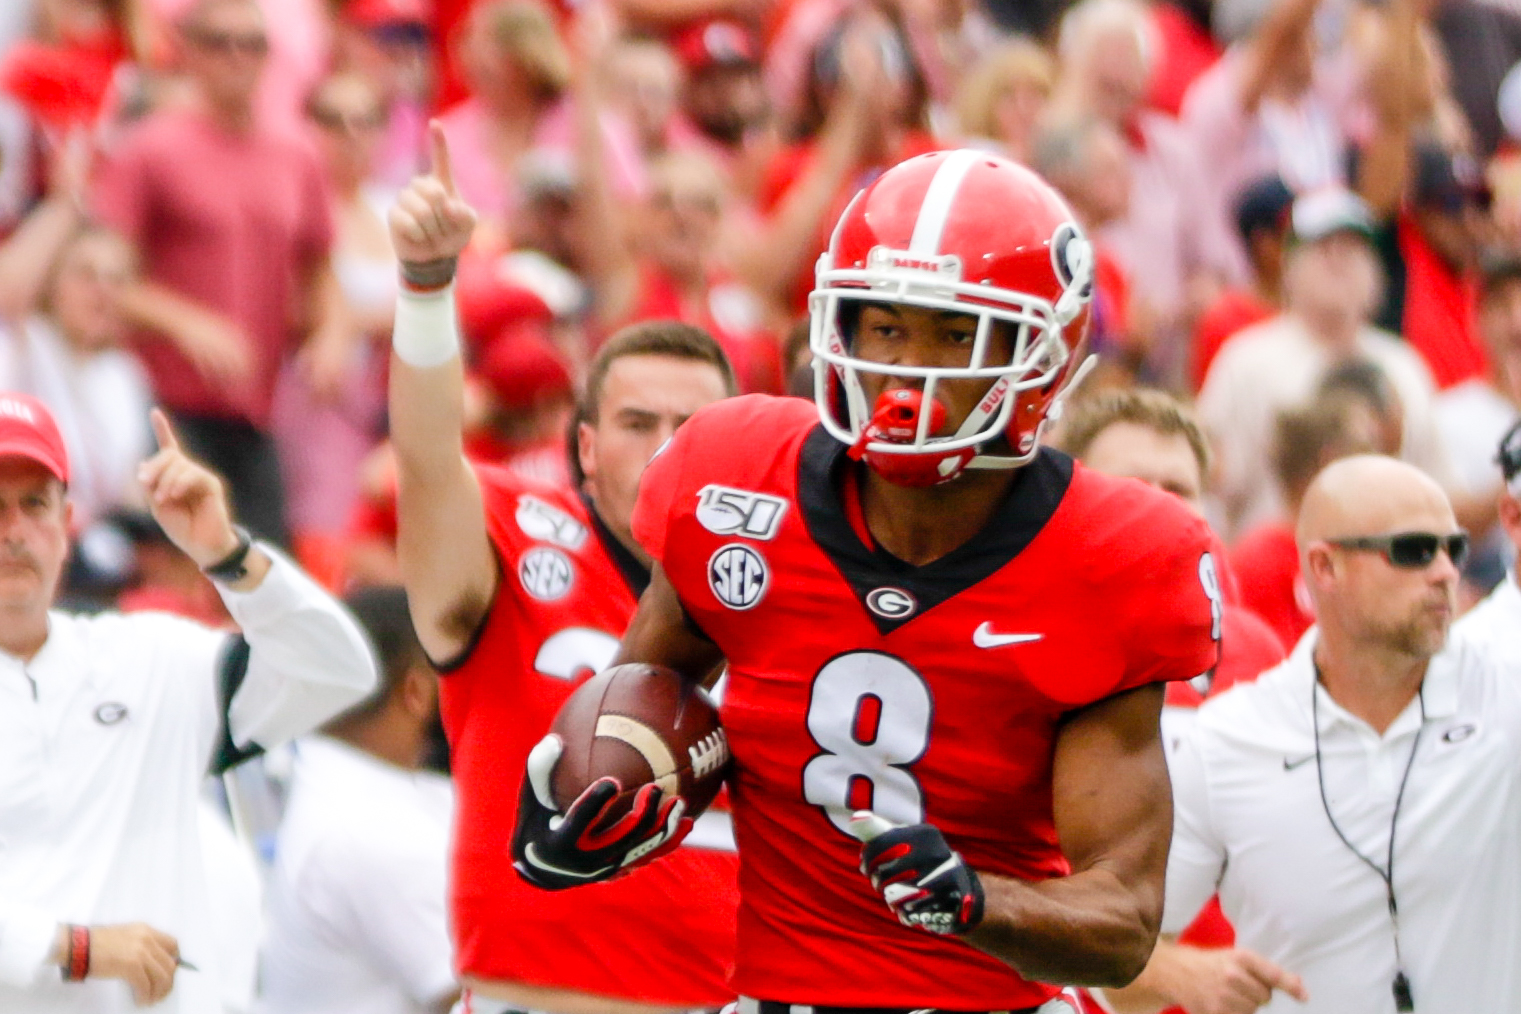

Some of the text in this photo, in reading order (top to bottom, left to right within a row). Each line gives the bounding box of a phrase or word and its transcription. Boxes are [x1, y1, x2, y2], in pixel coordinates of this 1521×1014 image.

[696, 484, 787, 540] 150
[711, 546, 766, 607] SEC
[804, 652, 932, 842] 8
